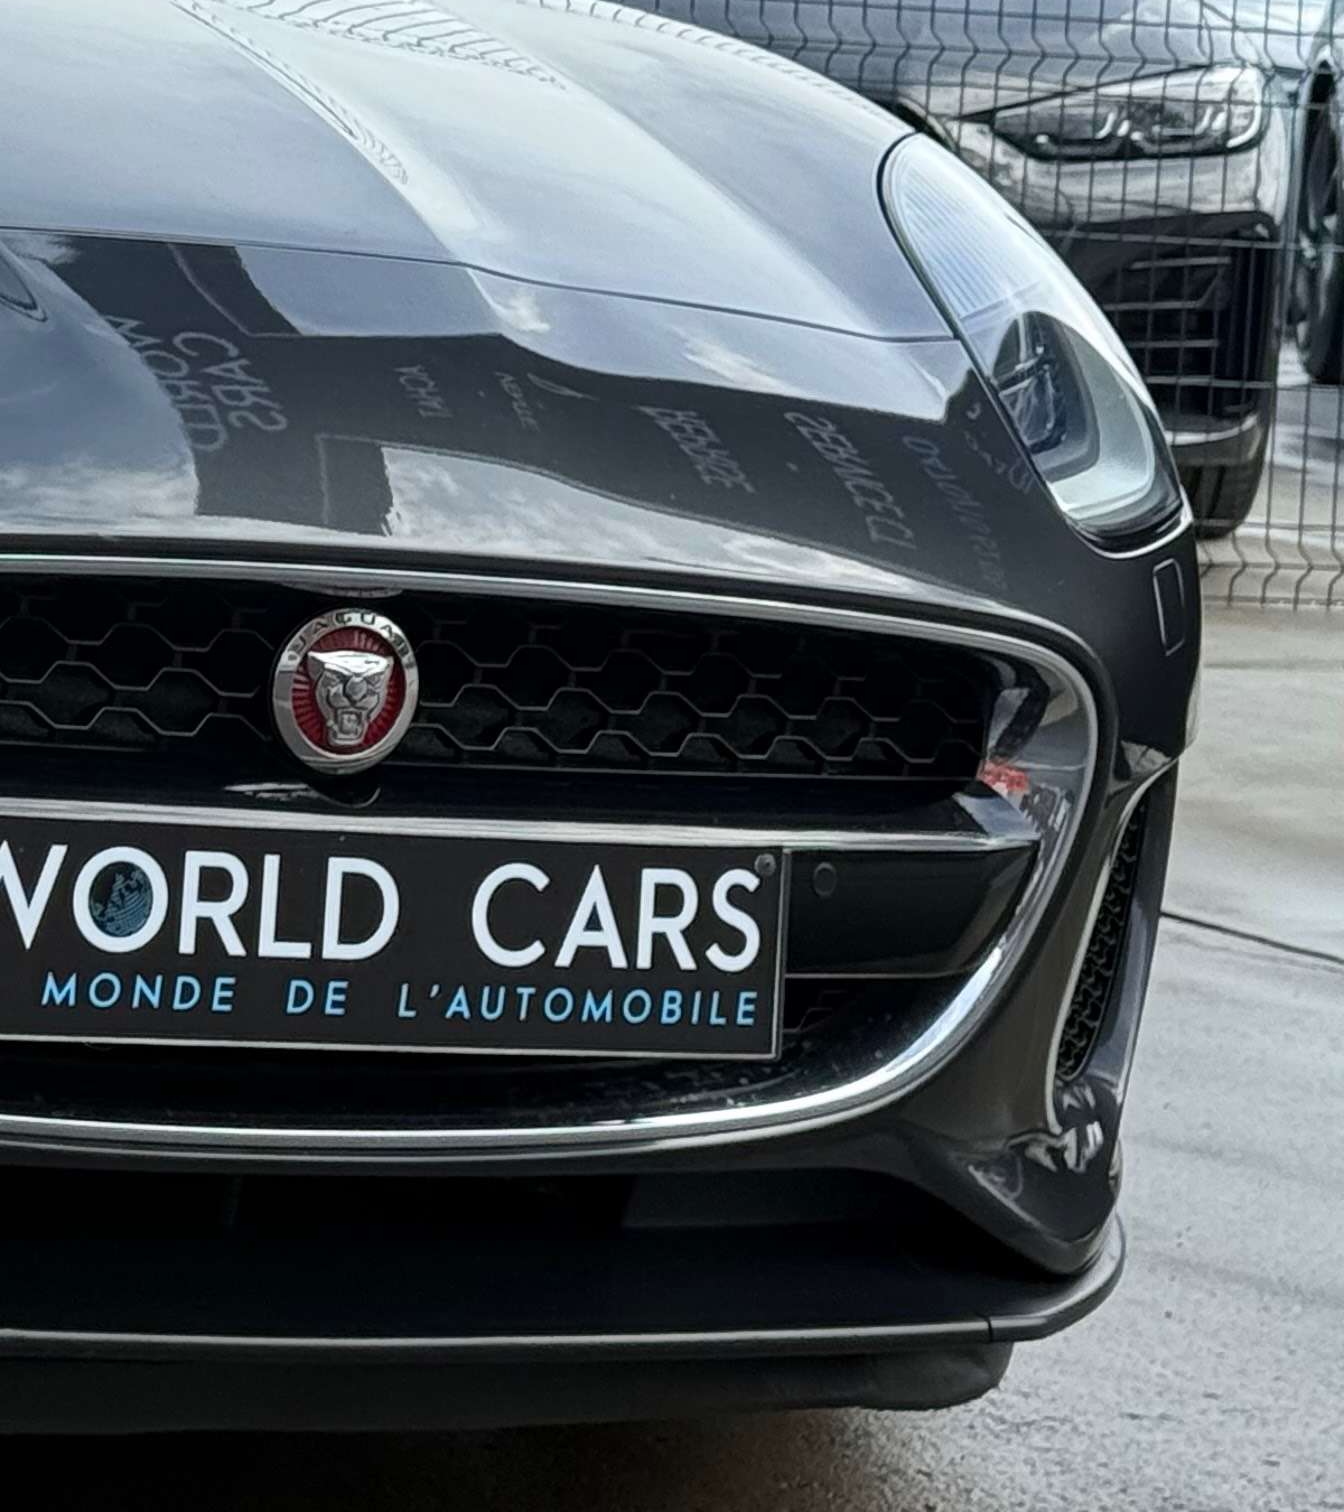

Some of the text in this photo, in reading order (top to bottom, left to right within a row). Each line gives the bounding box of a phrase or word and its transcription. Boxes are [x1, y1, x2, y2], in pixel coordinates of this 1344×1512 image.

[291, 611, 412, 660] JAGUAR
[471, 861, 762, 974] CARS
[40, 971, 238, 1013] MONDE
[285, 978, 350, 1017] DE
[397, 983, 759, 1026] L'AUTOMOBILE
